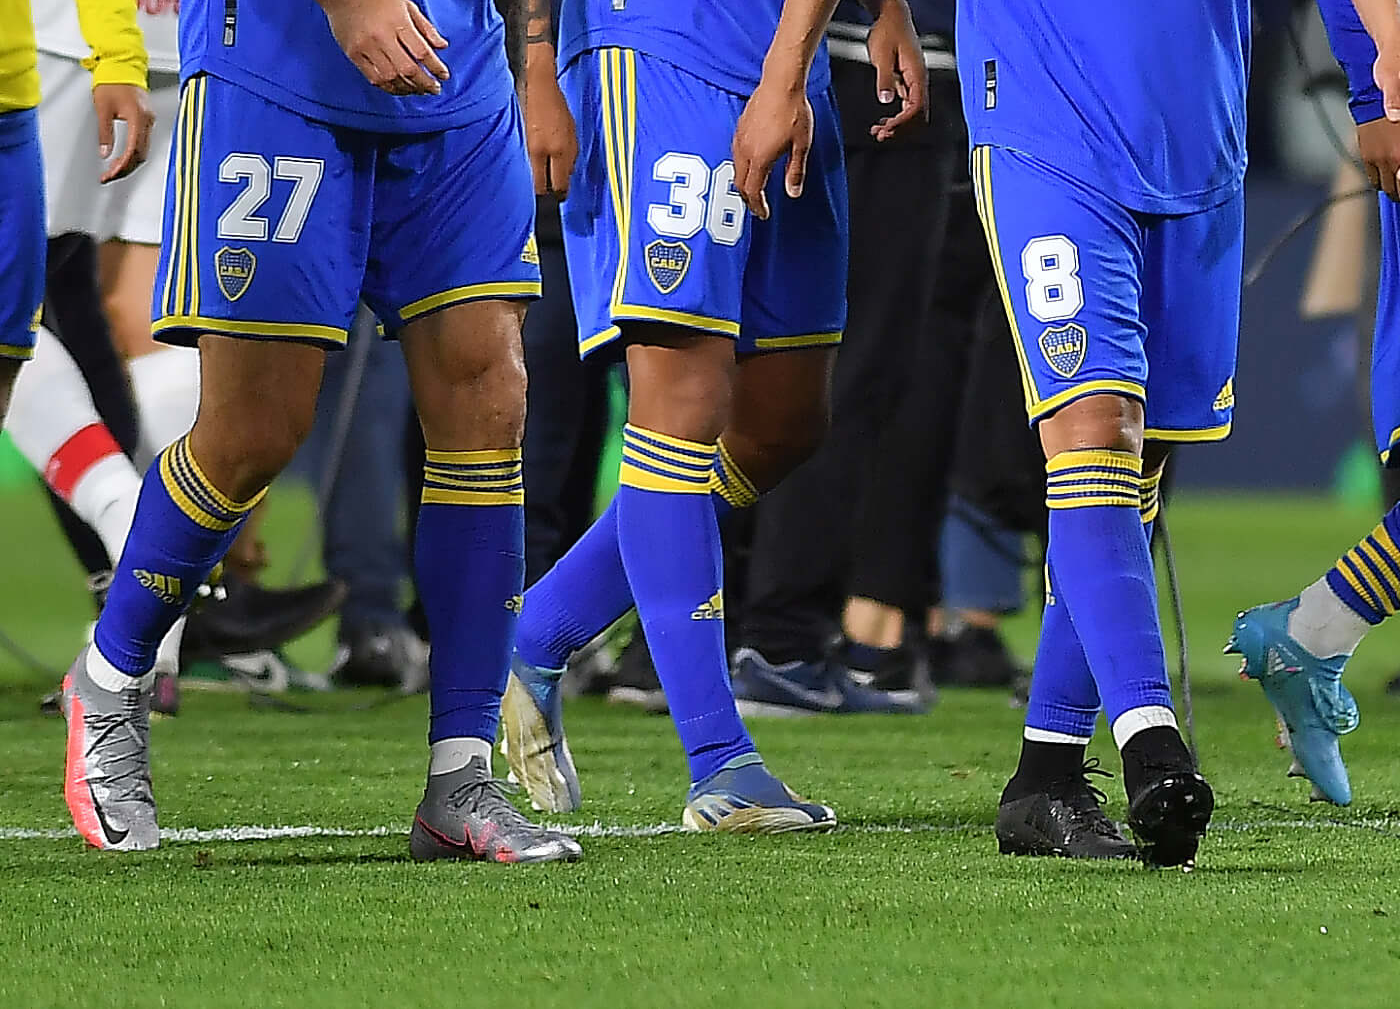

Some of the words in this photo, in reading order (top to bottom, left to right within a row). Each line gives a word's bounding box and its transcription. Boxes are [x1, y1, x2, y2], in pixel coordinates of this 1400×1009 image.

[217, 152, 325, 243] 27
[647, 151, 751, 246] 36
[1021, 235, 1085, 323] 8
[1047, 340, 1081, 356] CABJ
